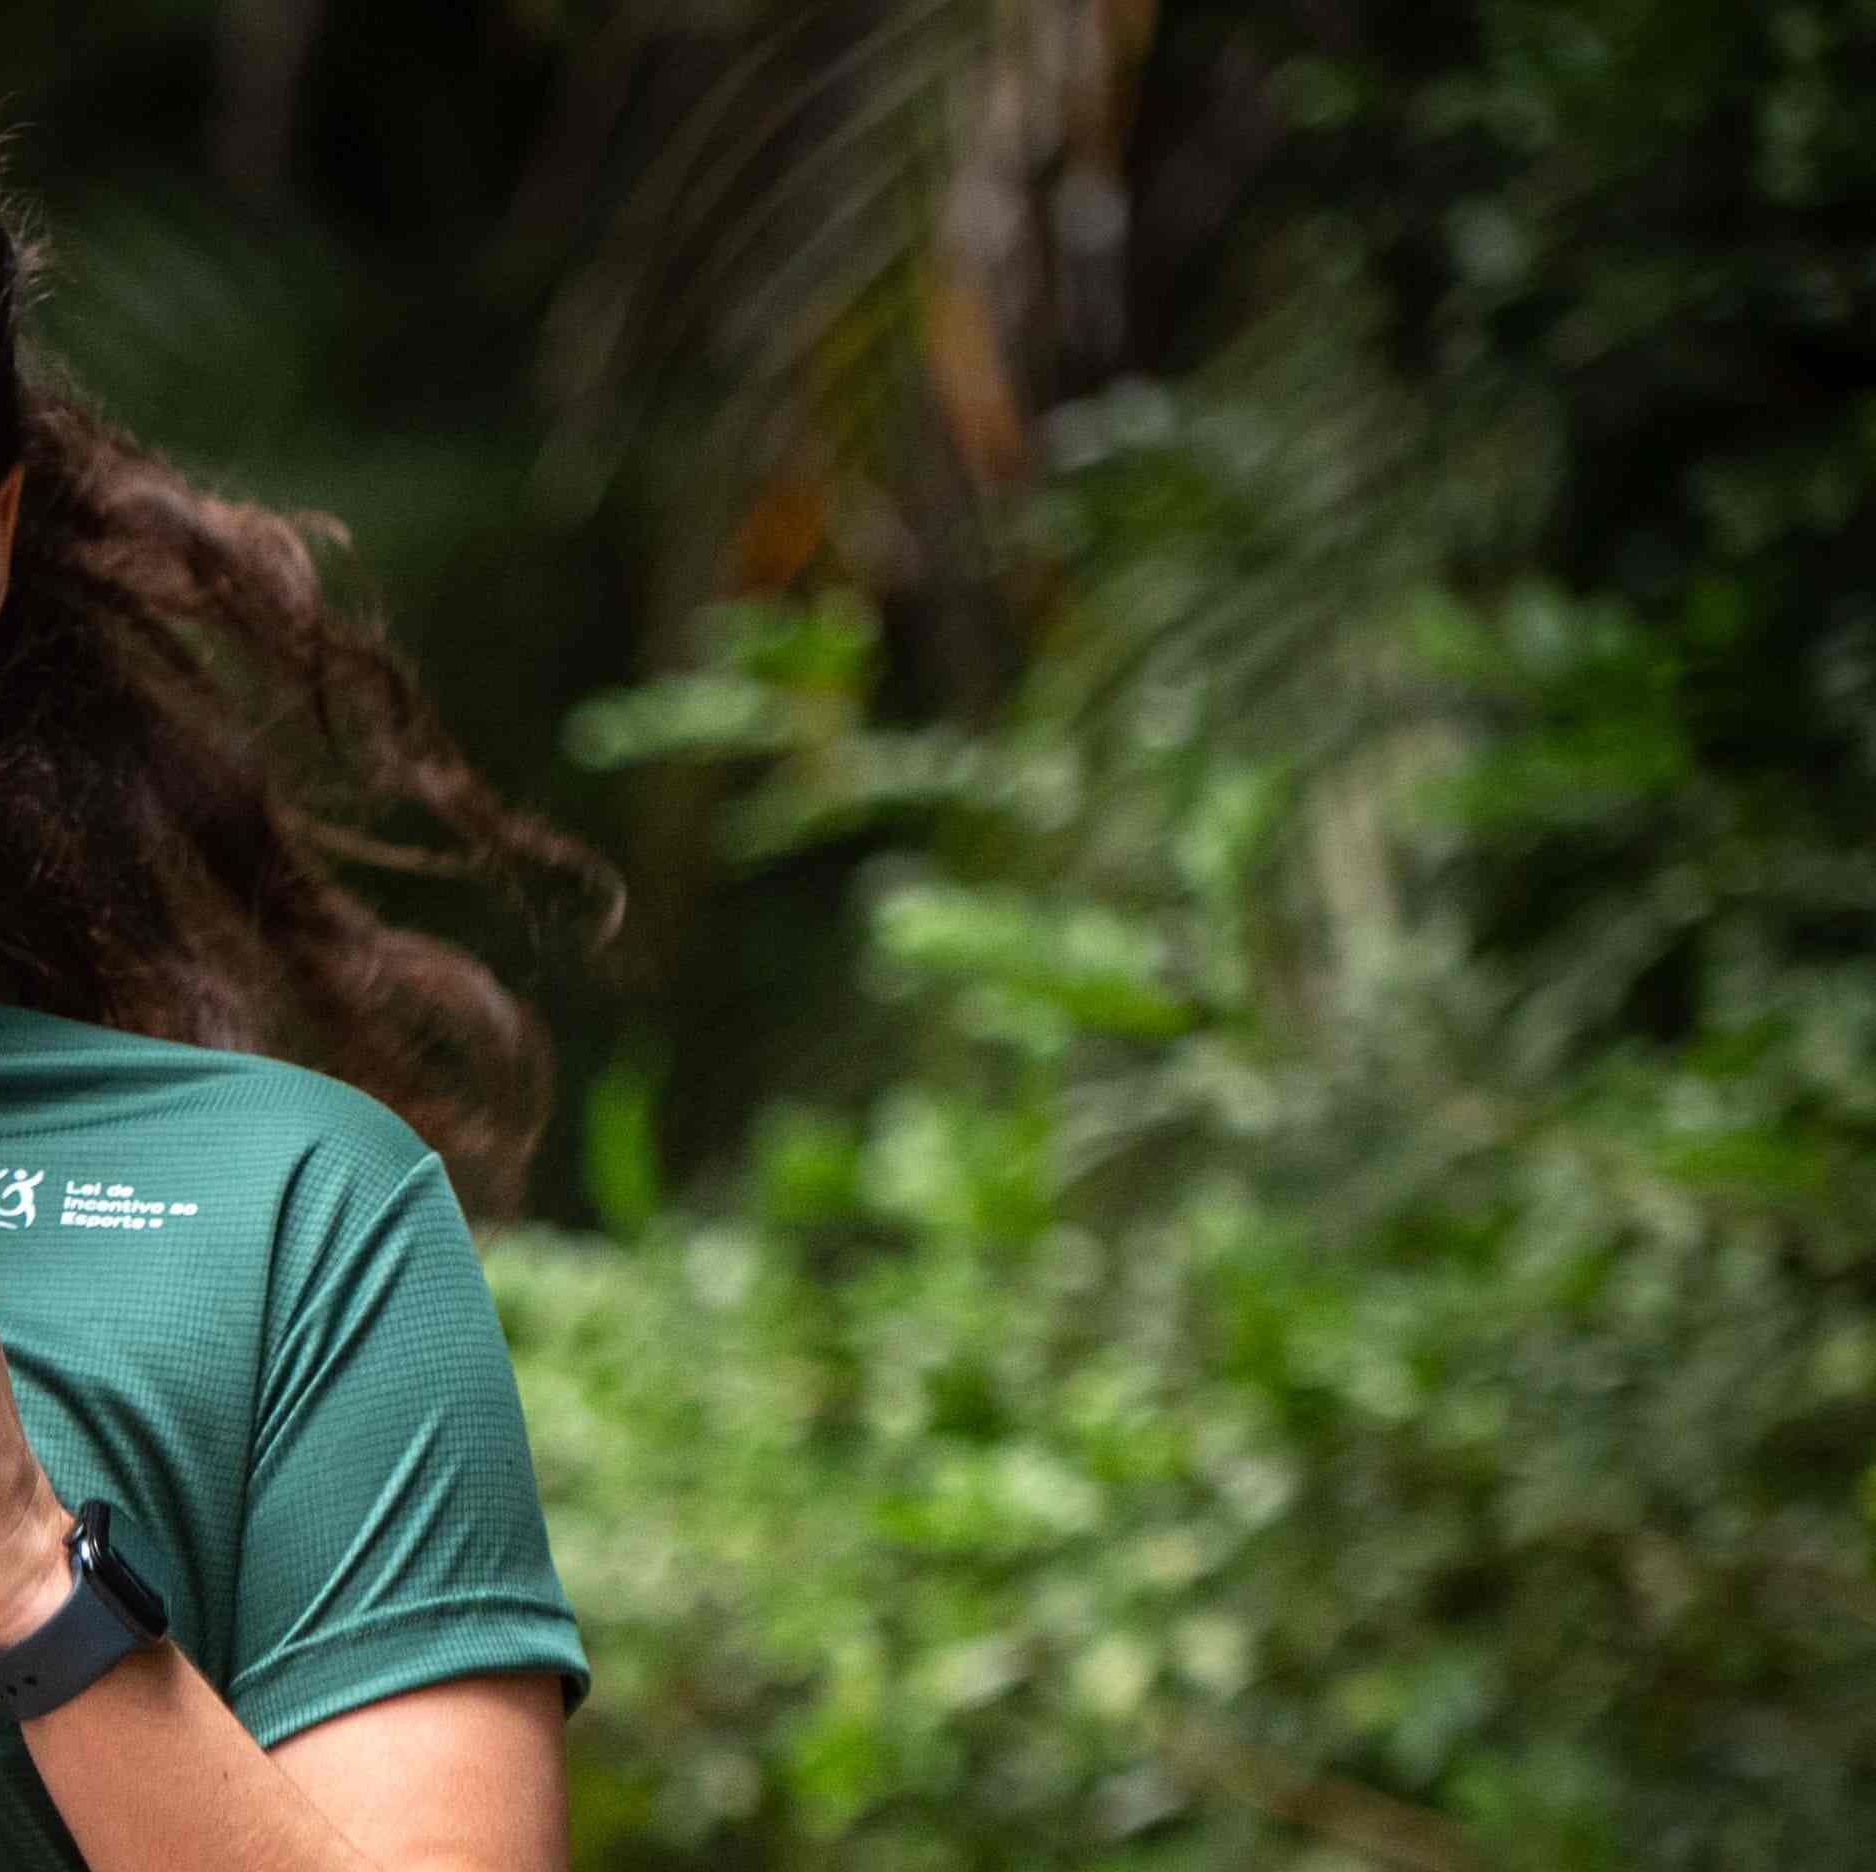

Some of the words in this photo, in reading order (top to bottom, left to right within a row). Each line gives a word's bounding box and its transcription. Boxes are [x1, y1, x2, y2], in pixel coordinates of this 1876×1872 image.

[65, 1180, 101, 1197] Lei
[106, 1184, 135, 1198] de
[62, 1196, 166, 1214] Incentivo
[168, 1202, 199, 1216] ao
[59, 1210, 145, 1229] Esporte
